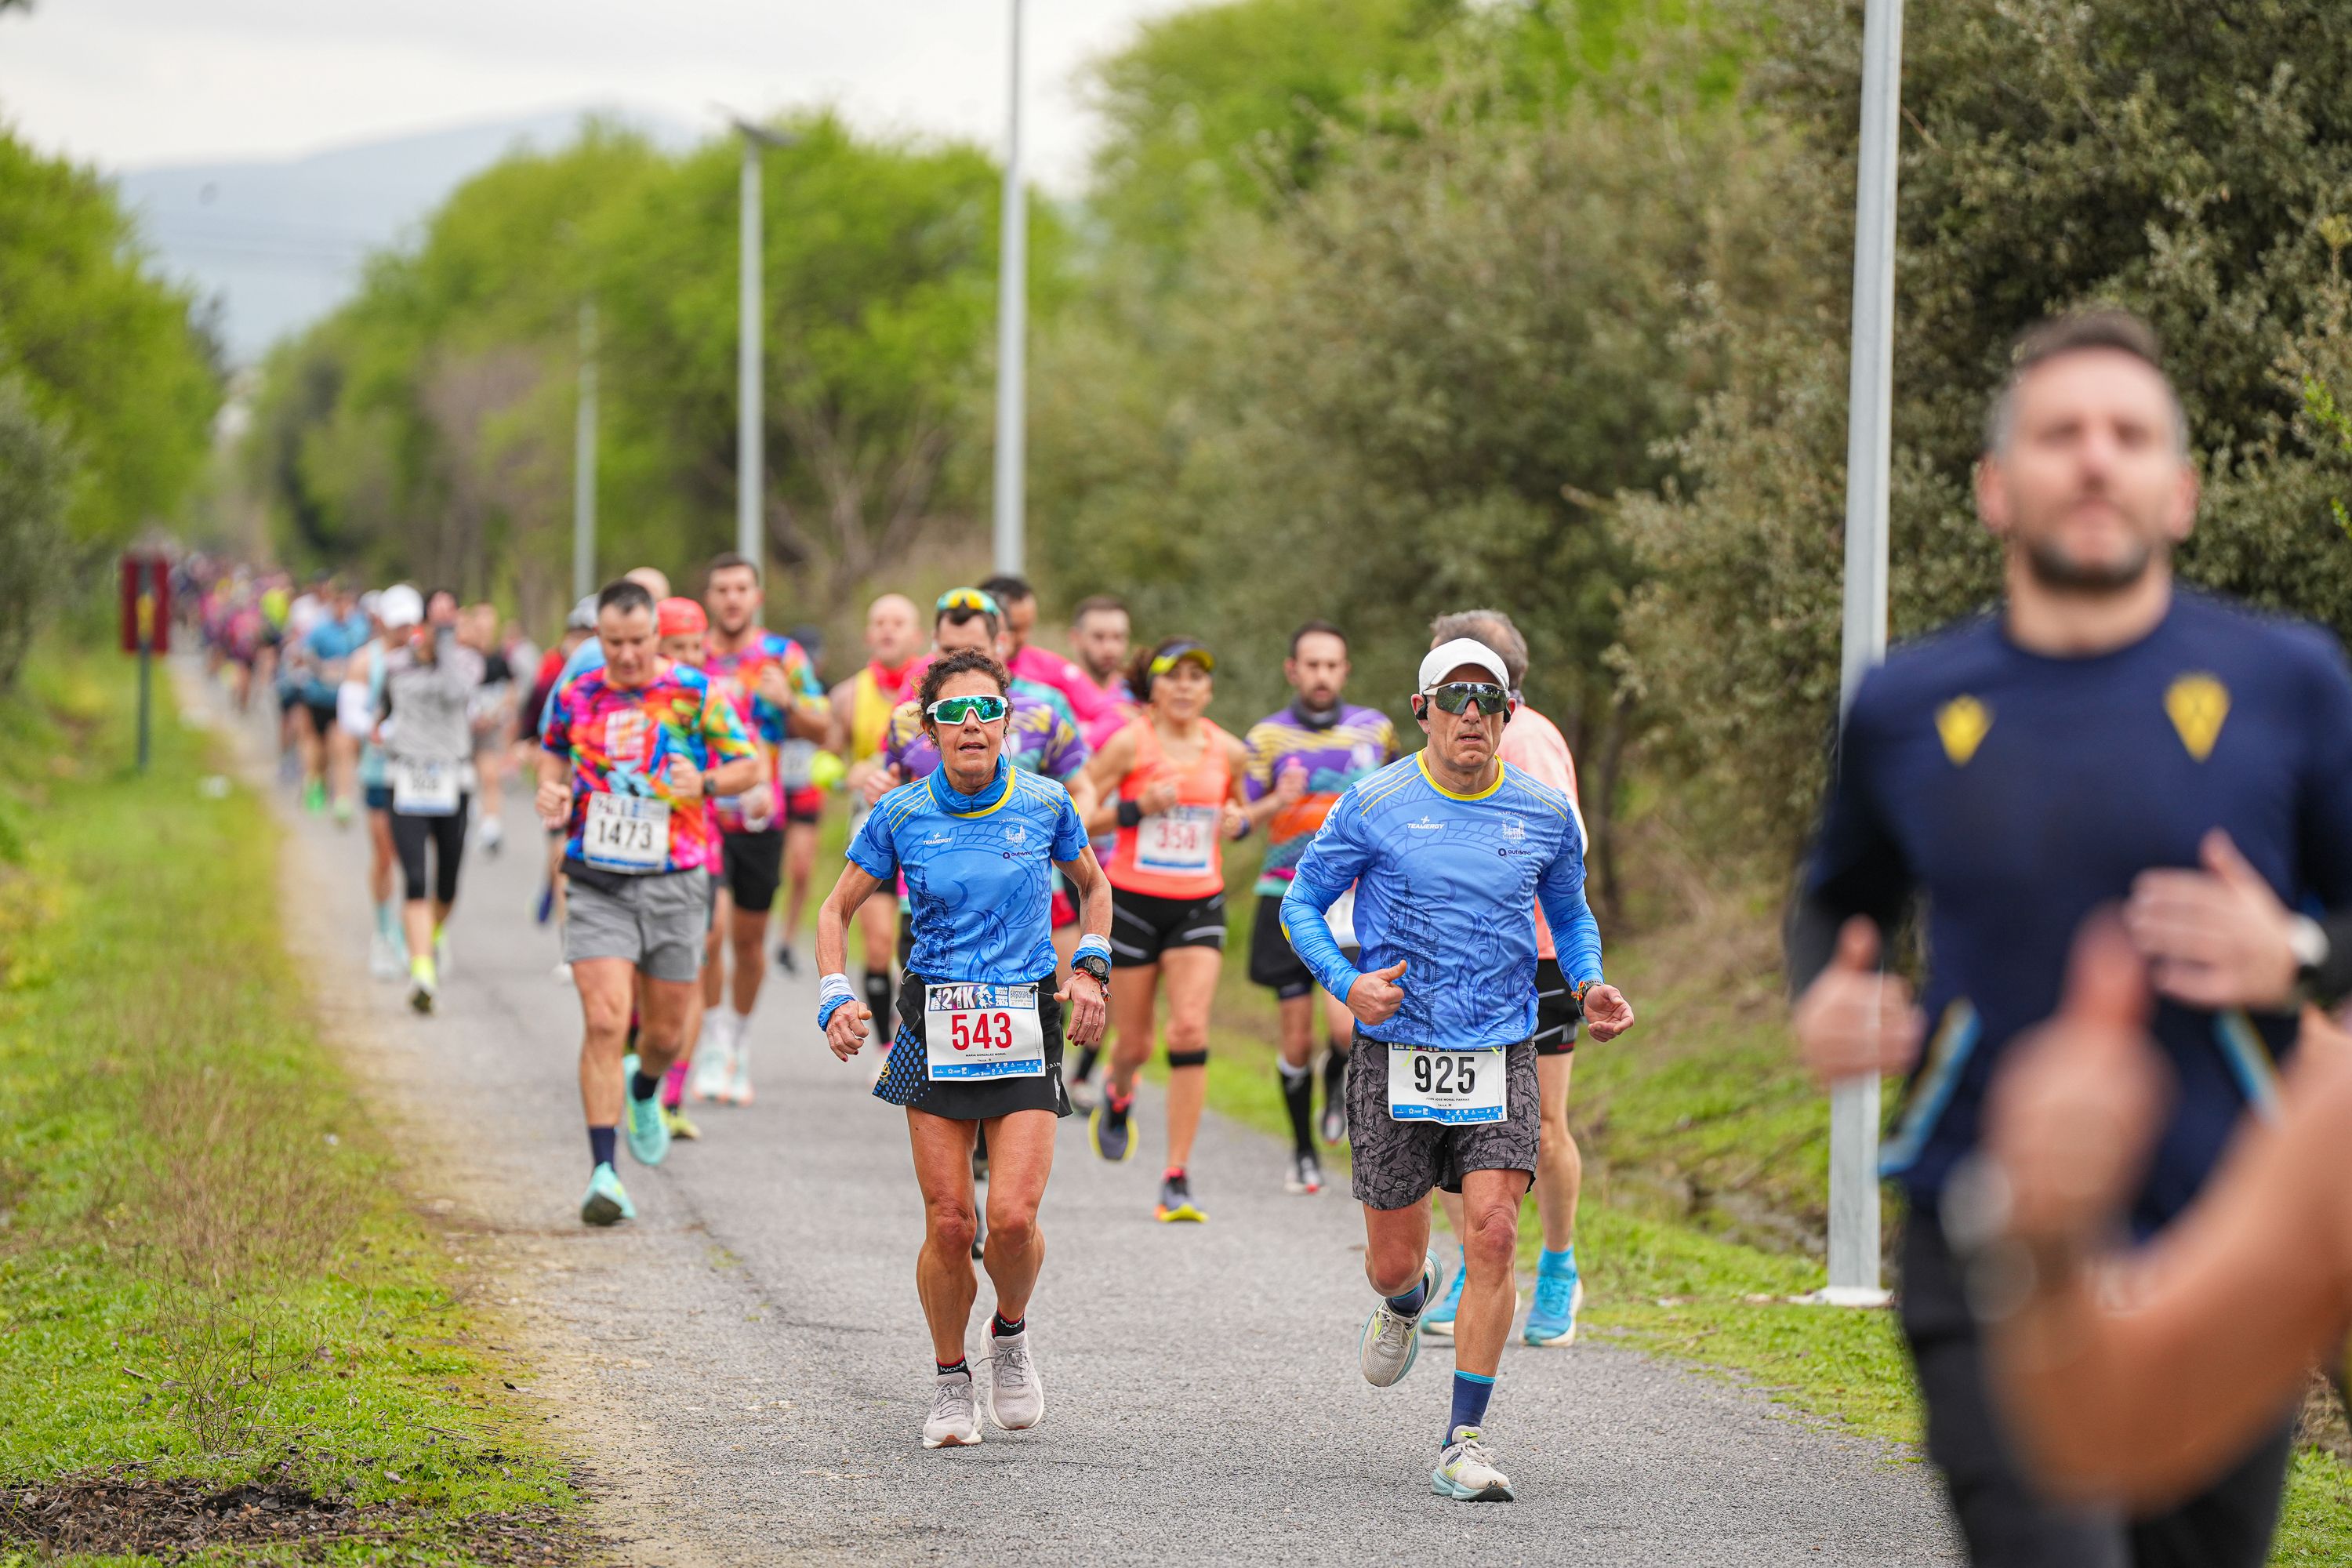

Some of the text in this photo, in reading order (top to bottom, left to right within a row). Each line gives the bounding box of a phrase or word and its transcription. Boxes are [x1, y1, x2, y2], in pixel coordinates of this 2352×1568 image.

[598, 819, 652, 849] 1473
[942, 986, 975, 1009] 21K
[951, 1012, 1012, 1051] 543
[1414, 1055, 1475, 1094] 925
